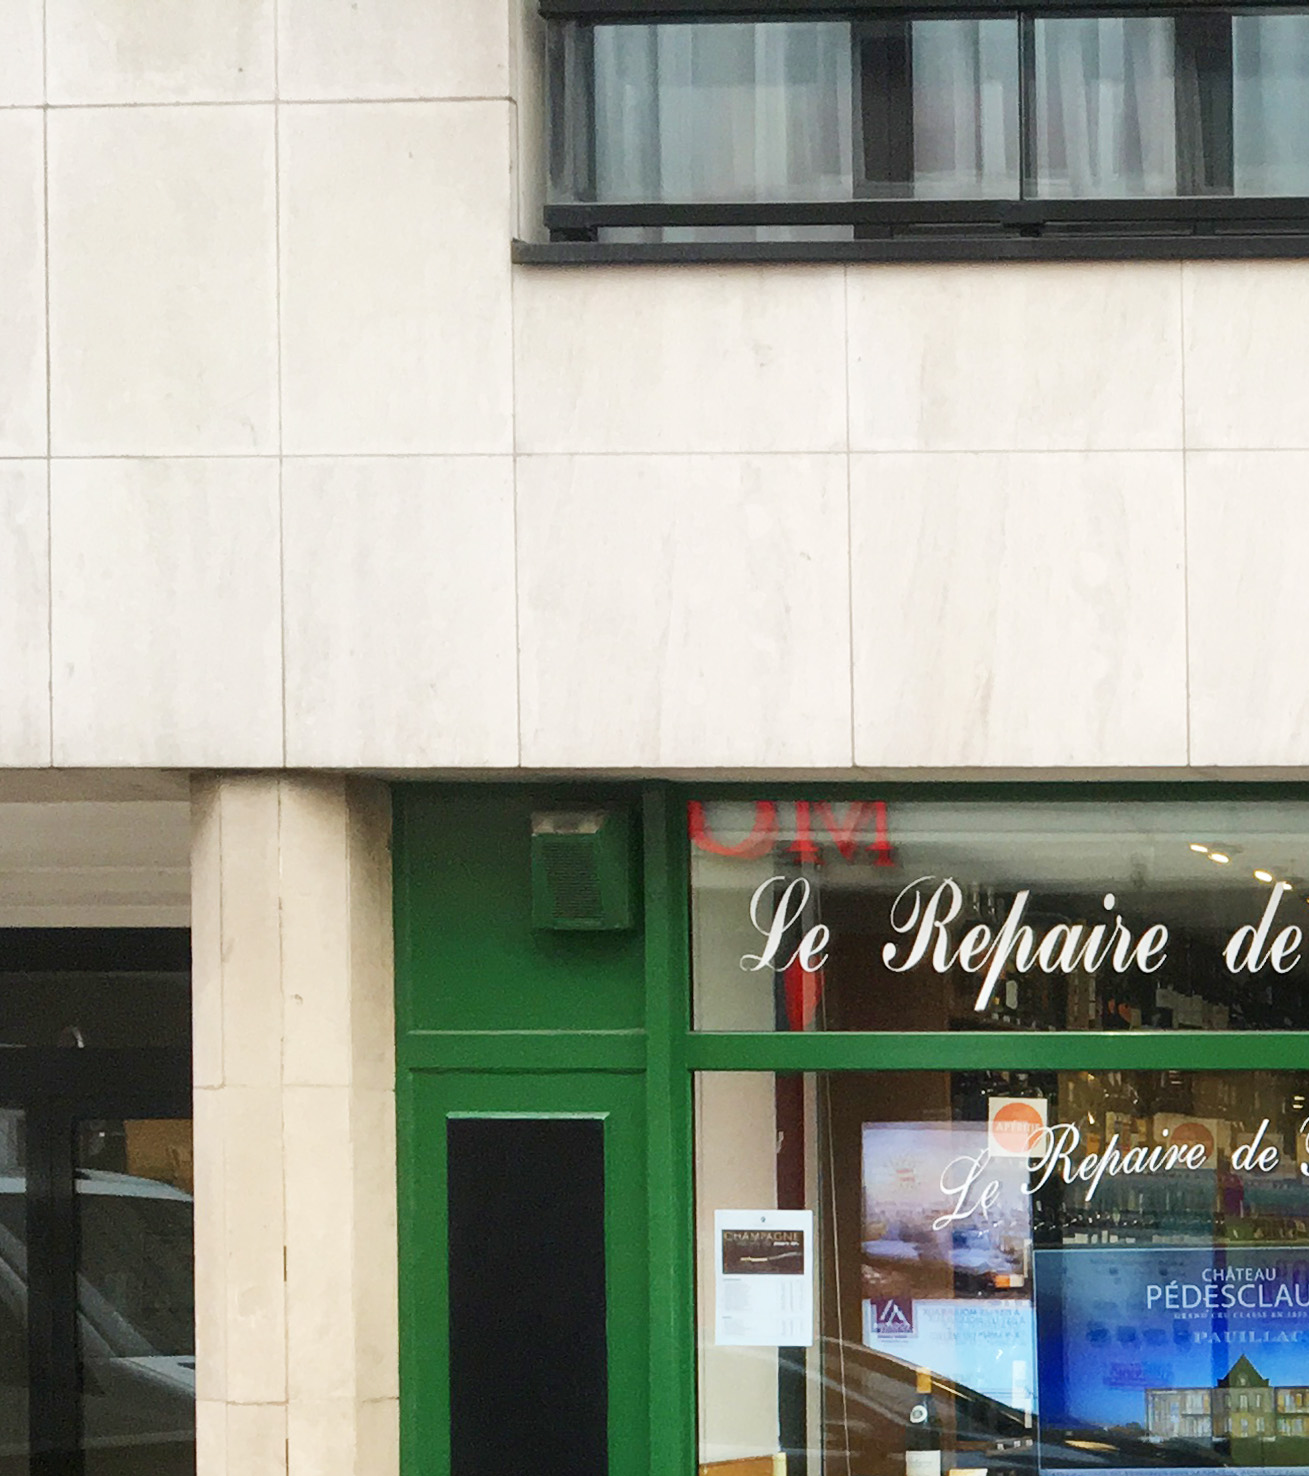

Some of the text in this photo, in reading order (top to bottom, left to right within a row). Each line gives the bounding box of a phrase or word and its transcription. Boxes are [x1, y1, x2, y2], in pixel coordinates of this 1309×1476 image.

[739, 874, 830, 974] Le
[881, 874, 1169, 1012] Repaire
[1224, 879, 1302, 975] de
[932, 1148, 1000, 1231] Le
[1020, 1122, 1207, 1203] Repaire
[1231, 1119, 1279, 1173] de
[723, 1231, 800, 1241] CHAMPAGNE
[1201, 1265, 1277, 1282] CHÂTEAU
[1194, 1330, 1303, 1343] PAUILLAC
